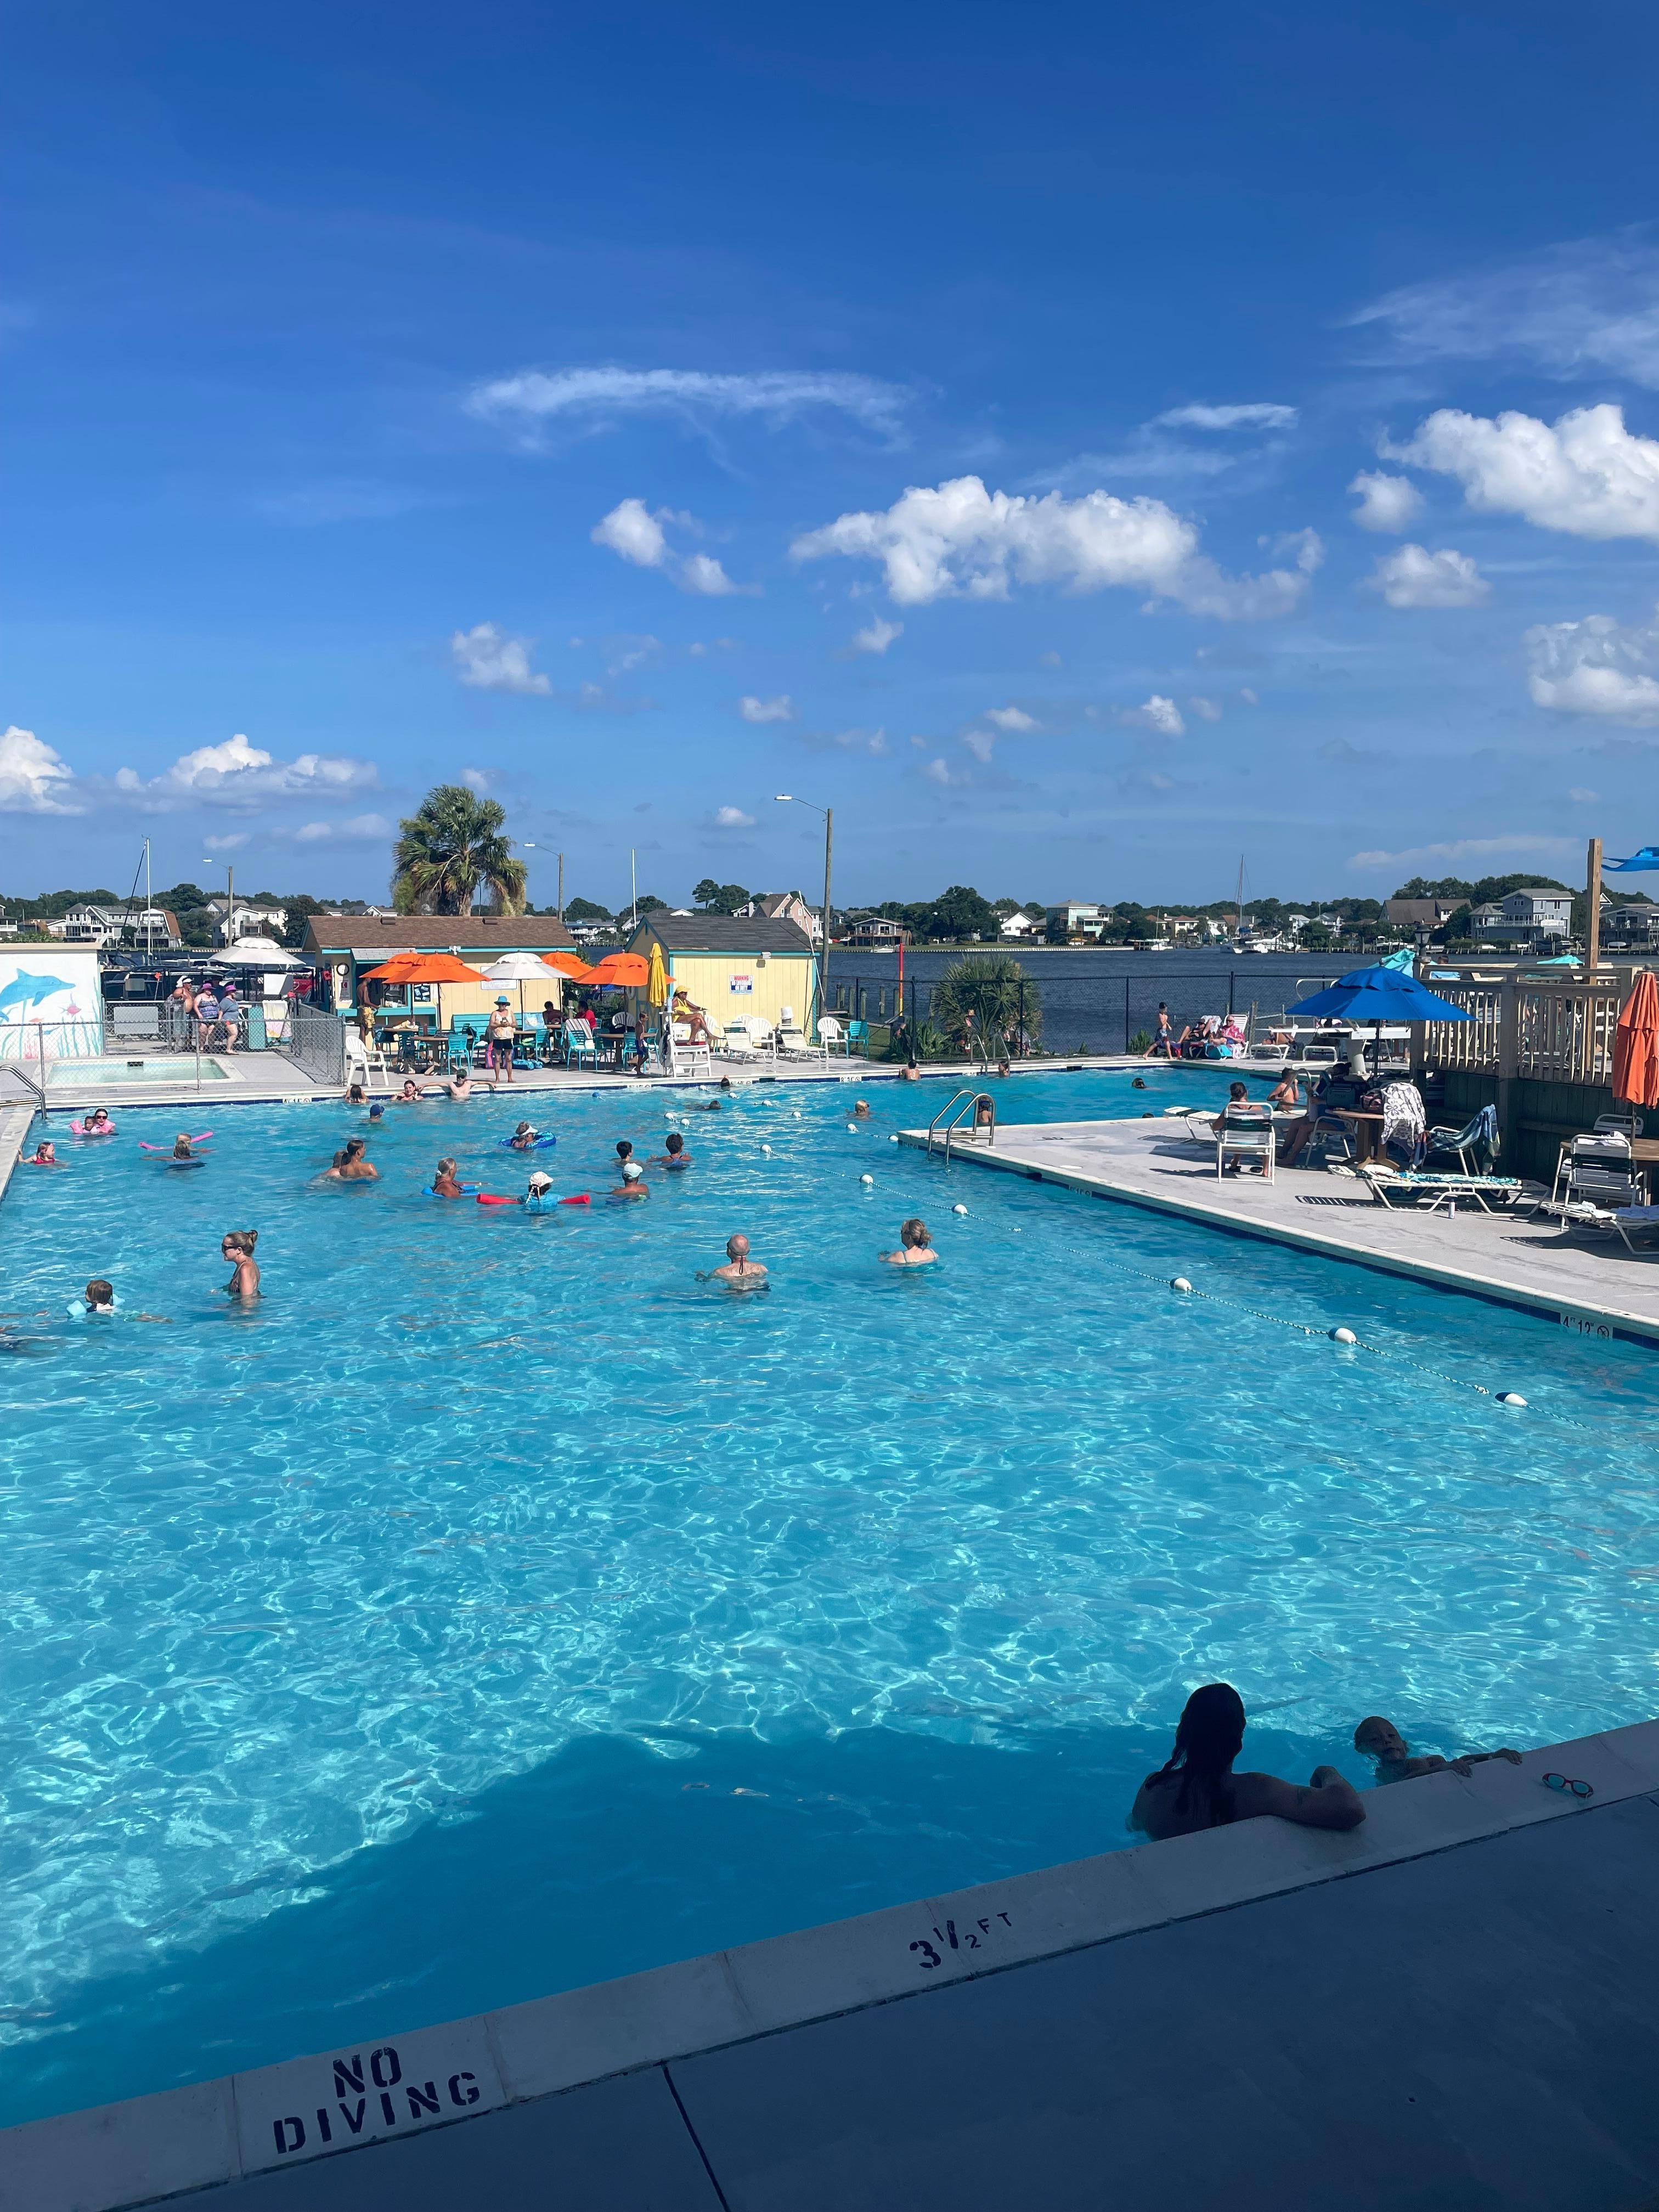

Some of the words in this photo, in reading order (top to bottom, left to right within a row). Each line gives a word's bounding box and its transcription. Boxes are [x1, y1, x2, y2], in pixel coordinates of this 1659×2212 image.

[977, 1912, 1012, 1934] FT
[332, 2047, 402, 2098] NO
[273, 2072, 480, 2154] DIVING
